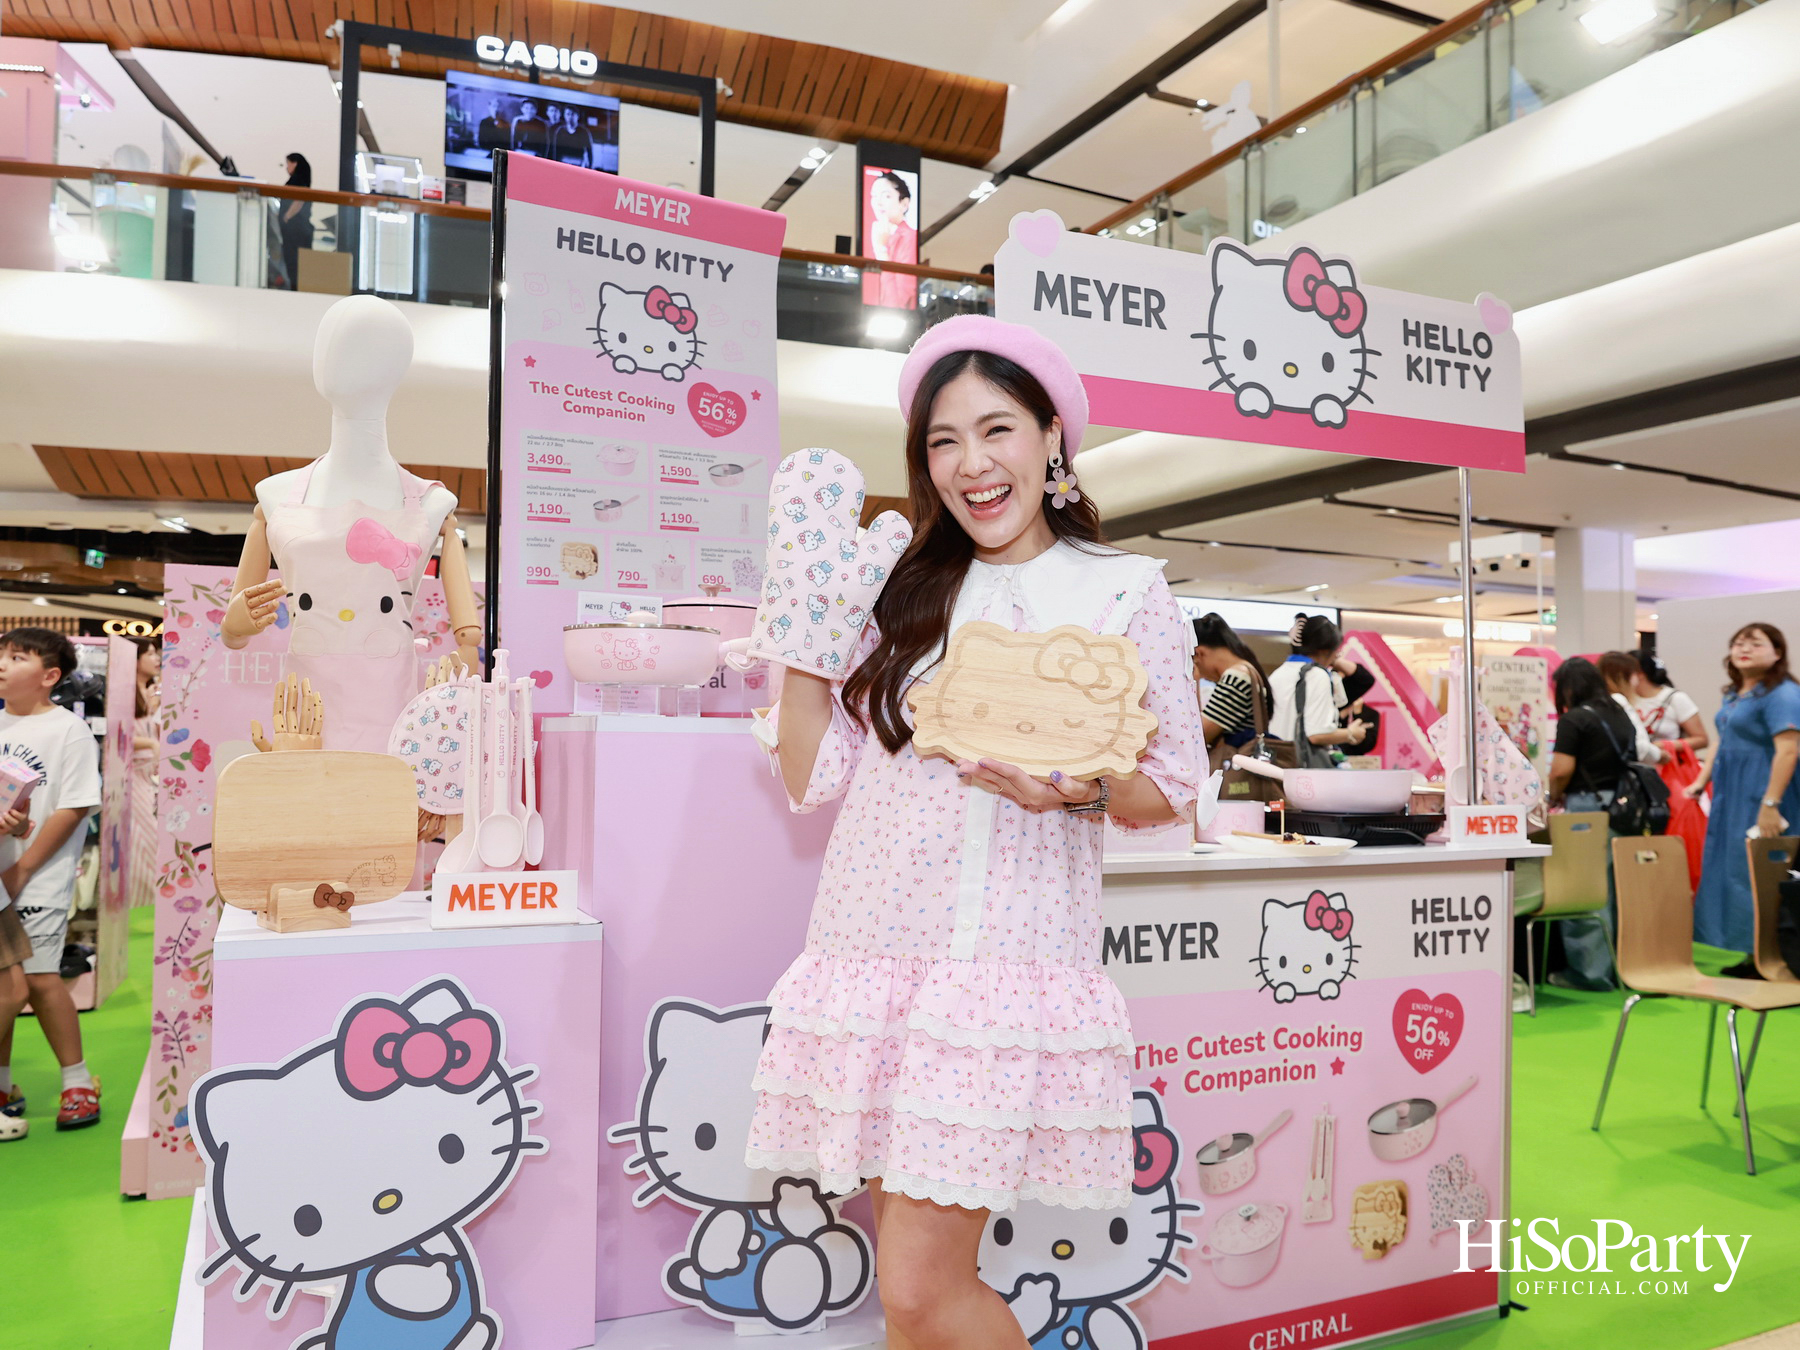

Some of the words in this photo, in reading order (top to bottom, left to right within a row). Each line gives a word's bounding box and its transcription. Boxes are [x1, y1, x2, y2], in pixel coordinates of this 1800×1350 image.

[476, 35, 598, 75] CASIO
[614, 188, 691, 226] MEYER
[556, 227, 646, 265] HELLO
[655, 248, 734, 283] KITTY
[1033, 270, 1168, 330] MEYER
[1403, 318, 1493, 359] HELLO
[1406, 354, 1492, 392] KITTY
[529, 381, 559, 395] The
[564, 384, 613, 401] Cutest
[617, 391, 675, 415] Cooking
[563, 400, 646, 422] Companion
[724, 418, 737, 426] OFF
[527, 452, 563, 466] 3,490
[660, 465, 692, 477] 1,590
[527, 503, 563, 515] 1,190
[660, 512, 692, 524] 1,190
[526, 566, 551, 578] 990
[617, 570, 640, 581] 790
[702, 574, 724, 585] 690
[1466, 815, 1519, 836] MEYER
[448, 881, 558, 912] MEYER
[1412, 895, 1492, 925] HELLO
[1102, 922, 1219, 965] MEYER
[1414, 927, 1490, 958] KITTY
[1411, 1003, 1433, 1012] ENJOY
[1434, 1006, 1444, 1014] UP
[1445, 1009, 1455, 1019] TO
[1405, 1013, 1451, 1047] 56%
[1133, 1044, 1179, 1070] The
[1187, 1031, 1266, 1059] Cutest
[1273, 1024, 1363, 1052] Cooking
[1414, 1047, 1434, 1061] OFF
[1184, 1058, 1316, 1093] Companion
[1249, 1313, 1353, 1350] CENTRAL
